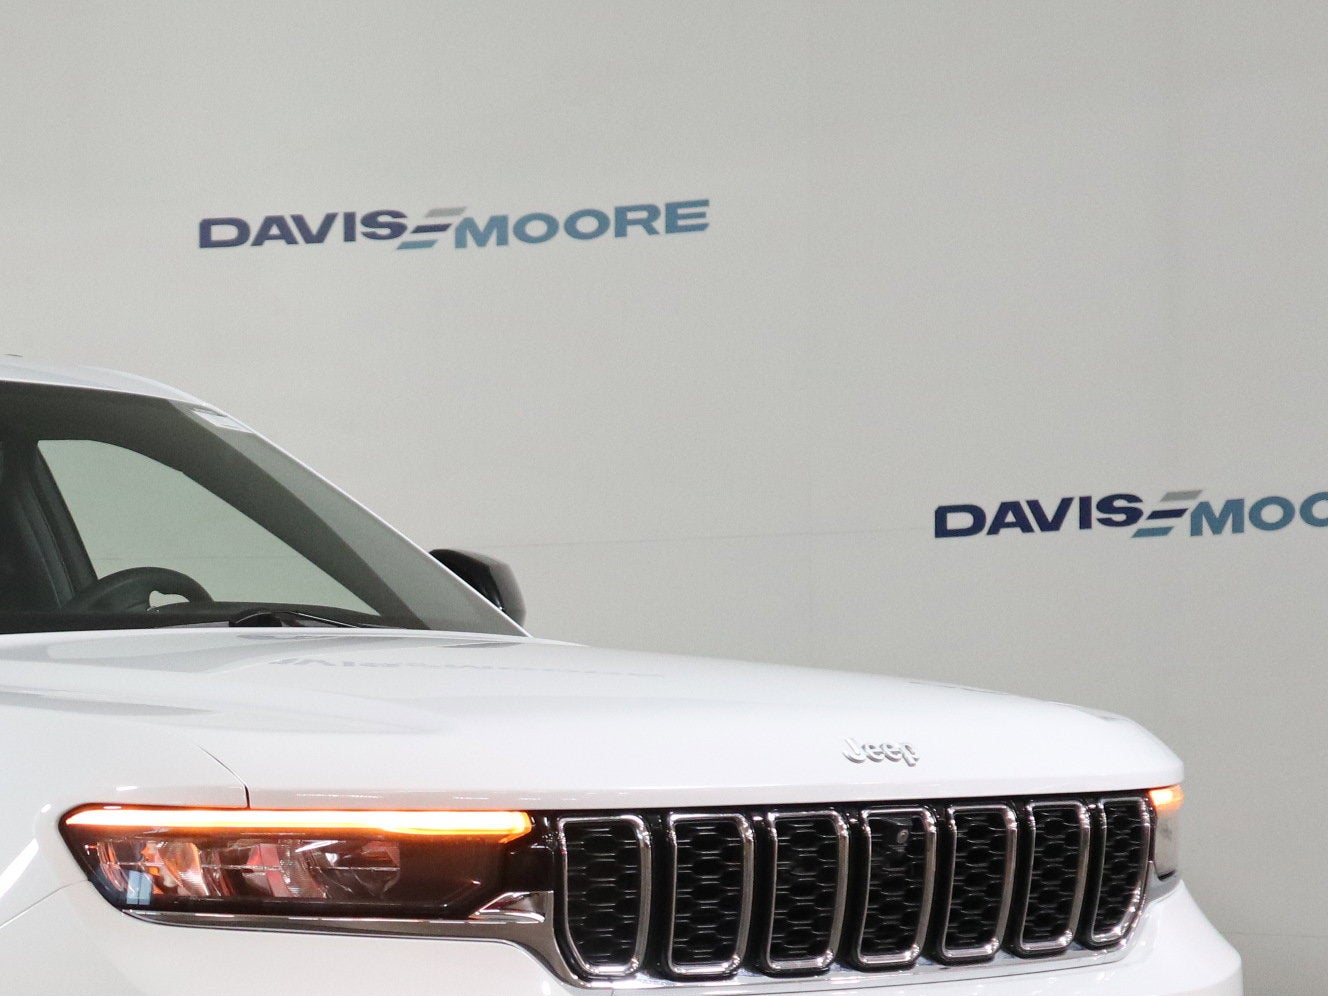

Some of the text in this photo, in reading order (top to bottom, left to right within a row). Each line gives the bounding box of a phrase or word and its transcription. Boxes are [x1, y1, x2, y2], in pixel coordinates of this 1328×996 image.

[199, 199, 710, 249] DAVIS MOORE
[934, 493, 1144, 538] DAVIS
[842, 737, 920, 767] Jeep
